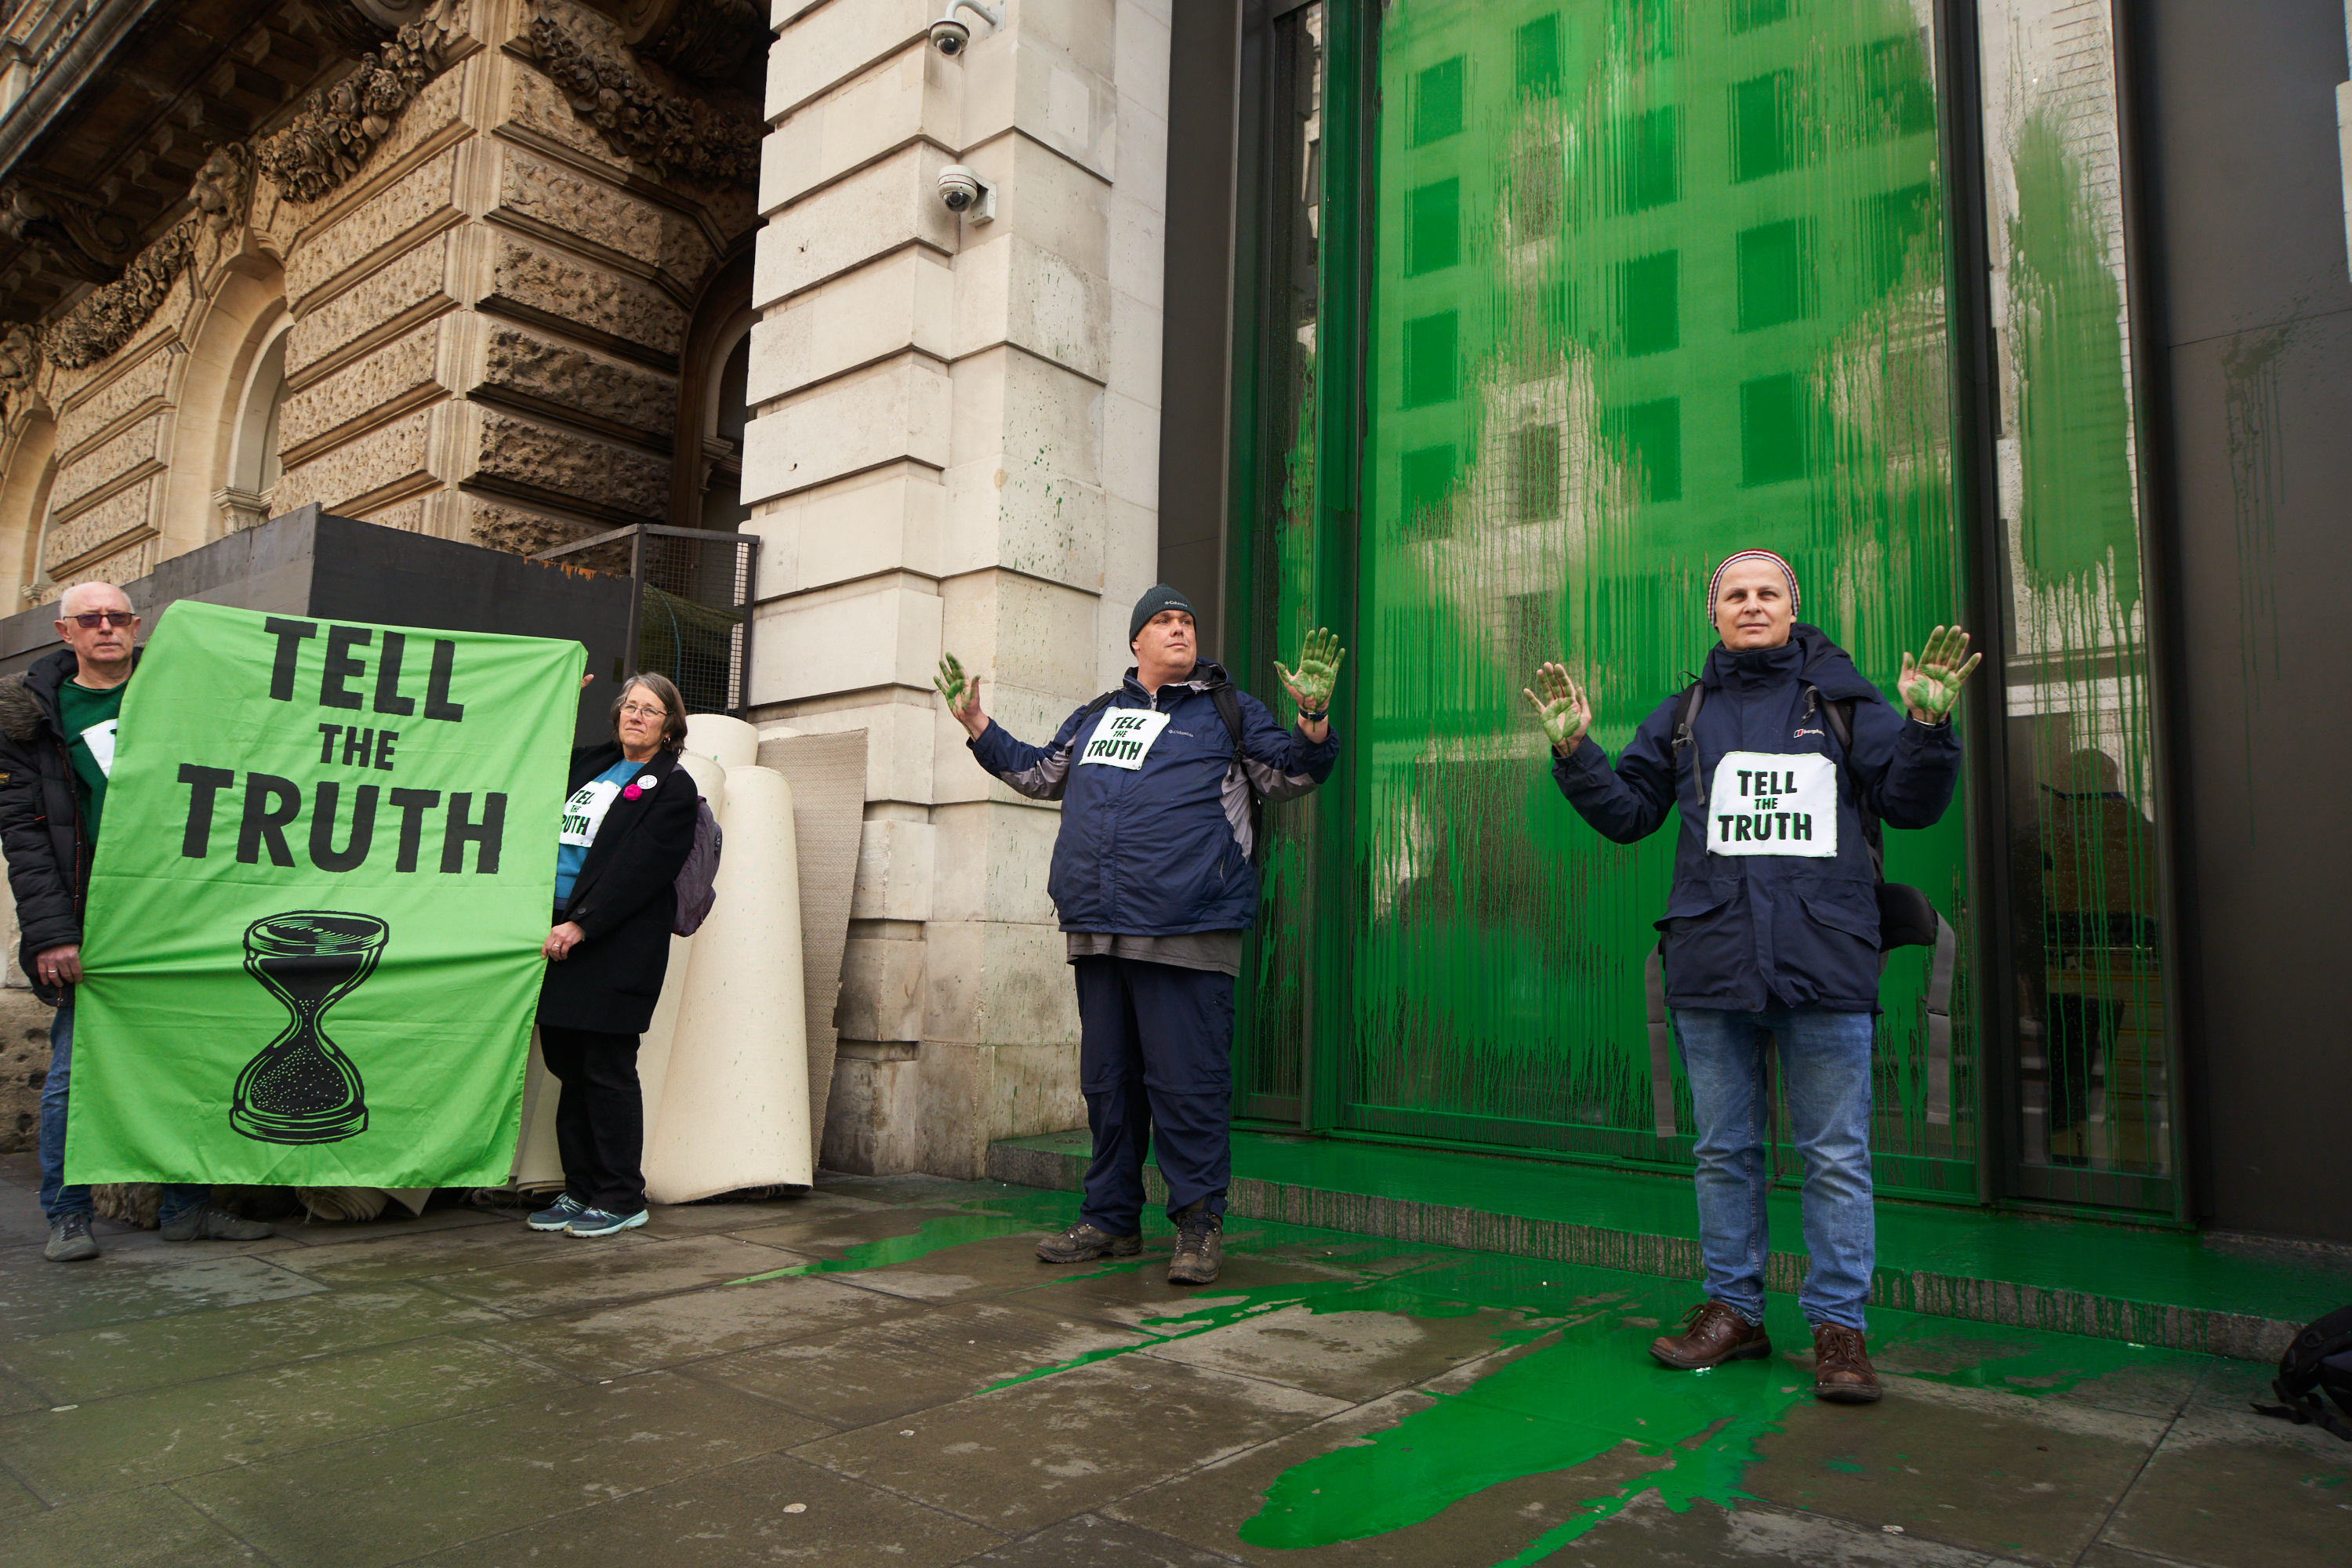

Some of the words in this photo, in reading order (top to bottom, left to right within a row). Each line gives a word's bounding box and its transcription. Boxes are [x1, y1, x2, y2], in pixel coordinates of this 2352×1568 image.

[264, 616, 464, 722] TELL
[1110, 717, 1147, 730] TELL
[318, 723, 399, 771] THE
[1087, 739, 1143, 760] TRUTH
[1737, 770, 1798, 797] TELL
[1755, 797, 1778, 810] THE
[177, 763, 507, 874] TRUTH
[1717, 812, 1813, 842] TRUTH
